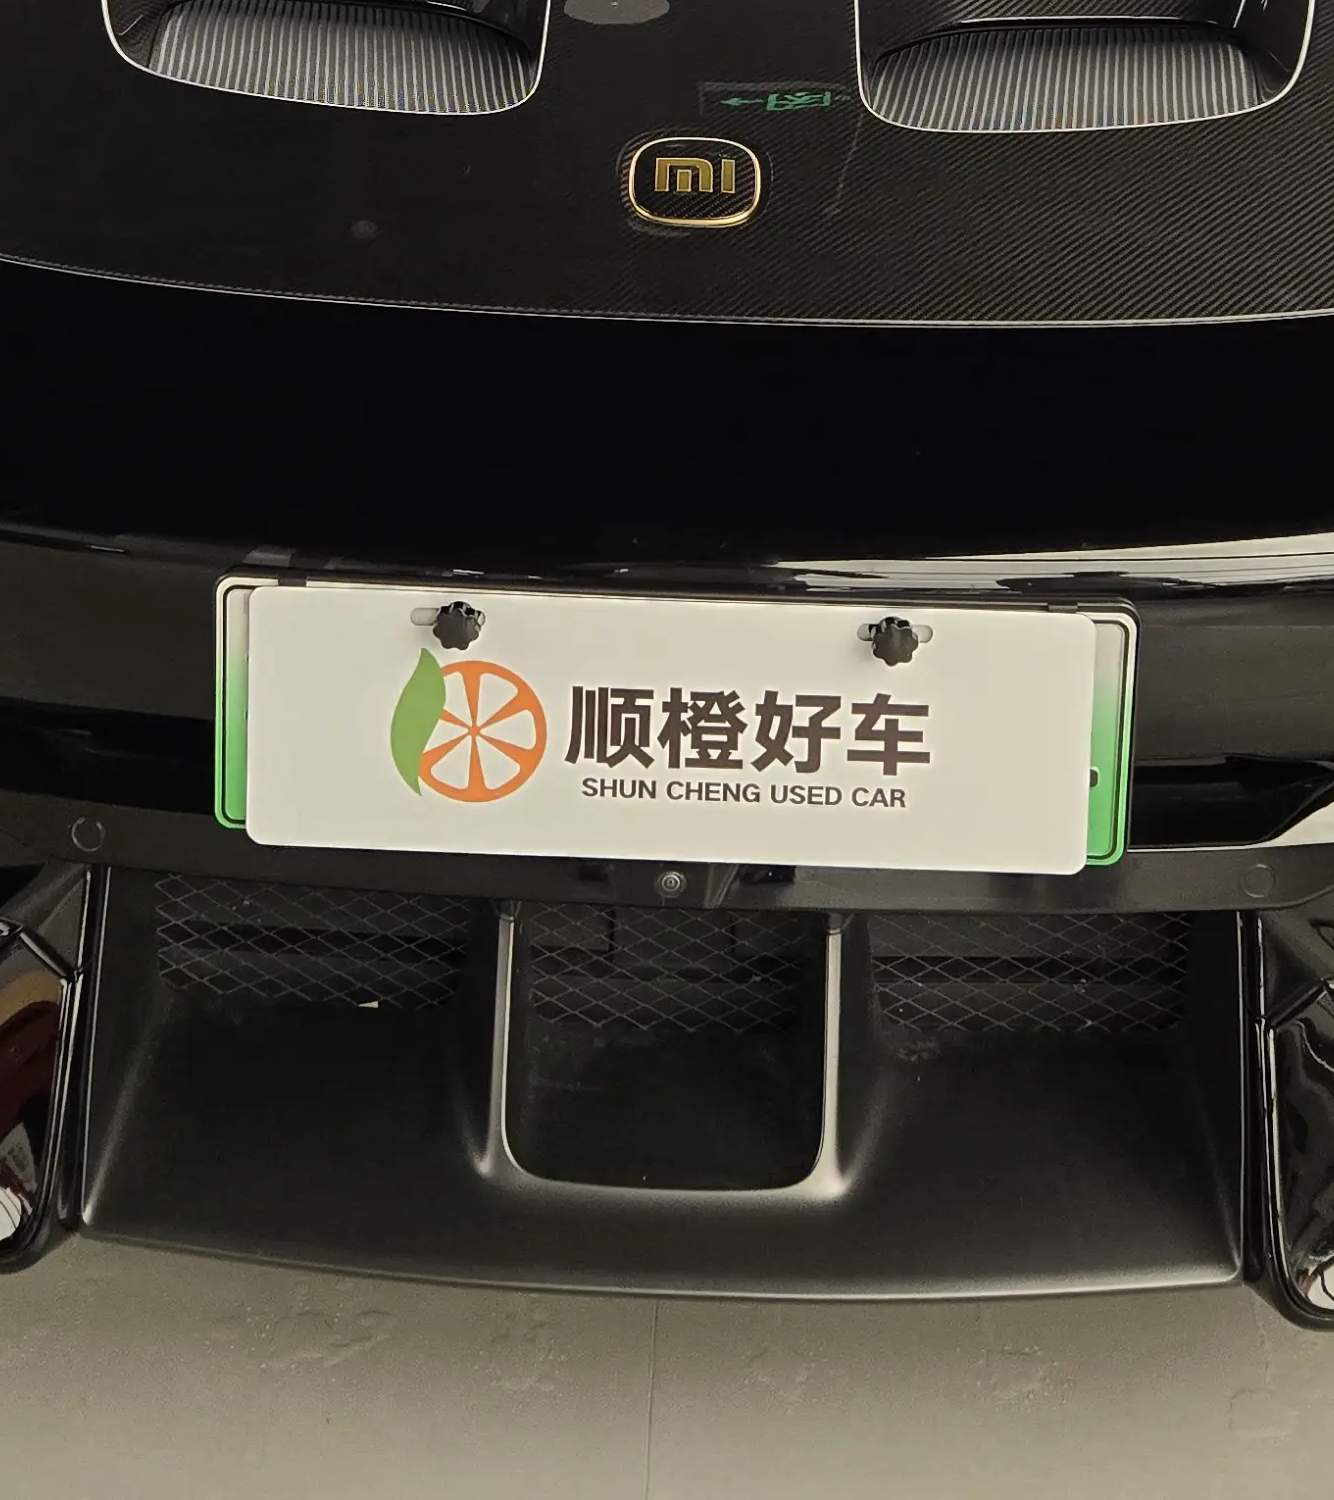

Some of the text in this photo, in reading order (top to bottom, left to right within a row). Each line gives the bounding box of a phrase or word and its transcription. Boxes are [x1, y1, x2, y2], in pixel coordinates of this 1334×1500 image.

[564, 685, 931, 777] 顺橙好车
[581, 777, 907, 809] SHUN CHENG USED CAR
